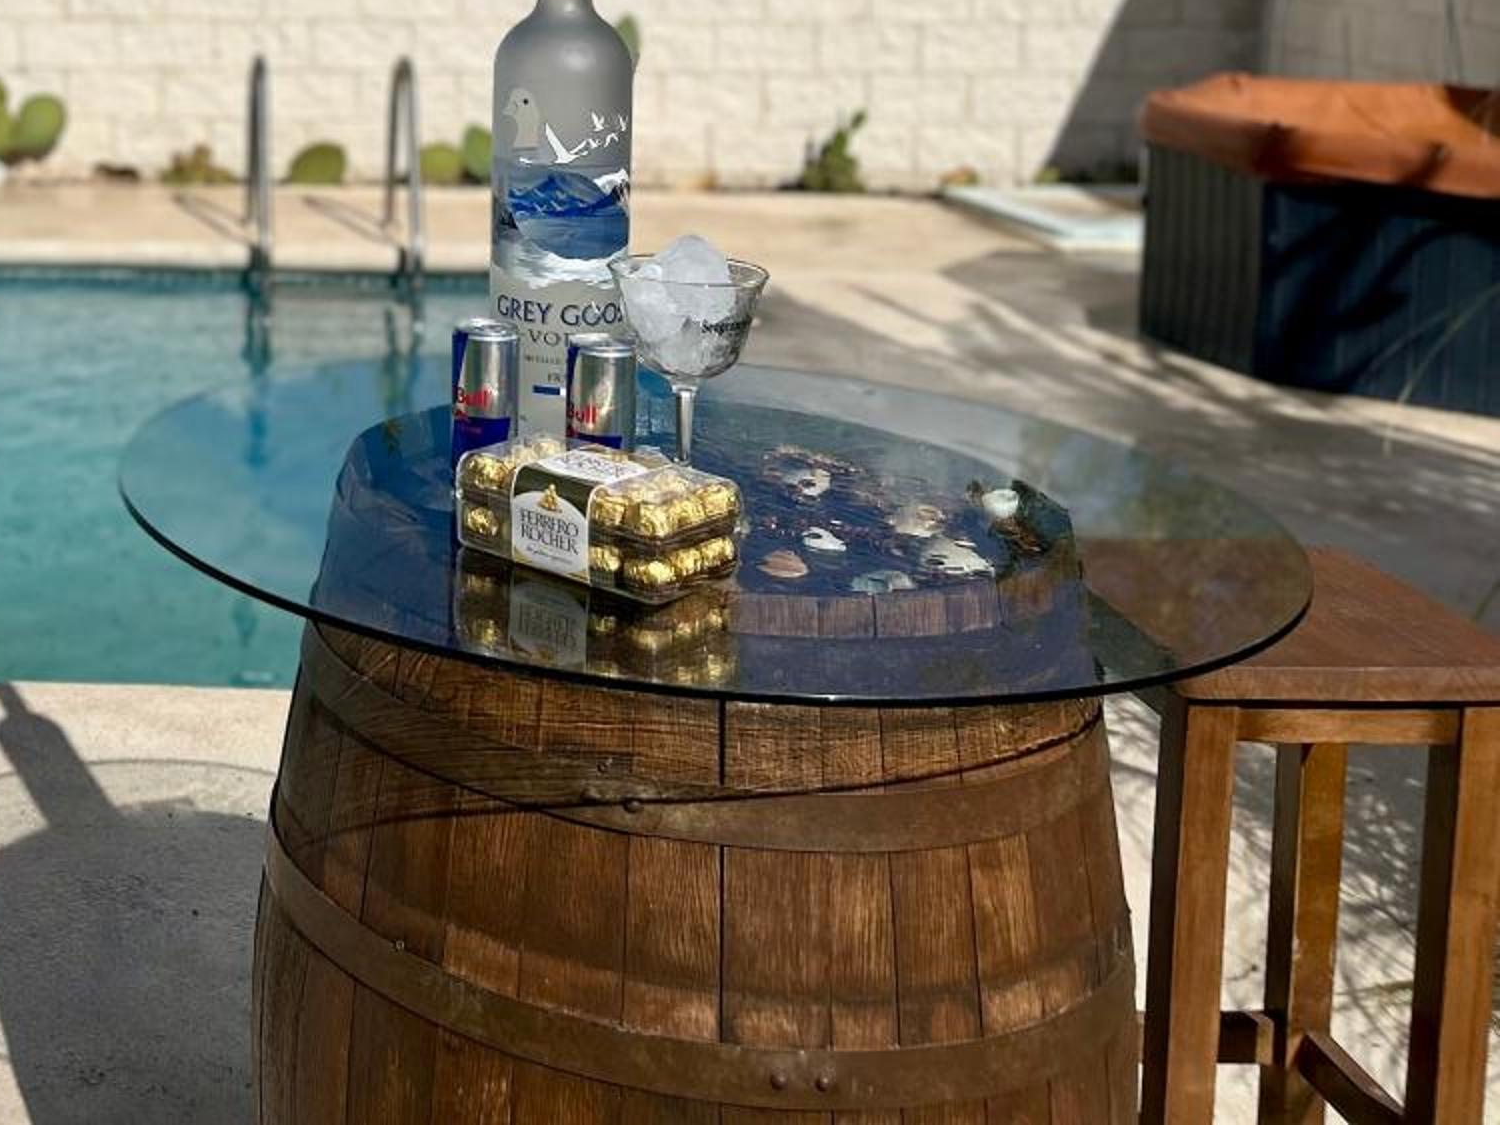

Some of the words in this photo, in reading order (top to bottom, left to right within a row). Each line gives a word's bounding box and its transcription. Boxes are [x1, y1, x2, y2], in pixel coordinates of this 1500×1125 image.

[497, 294, 551, 324] GREY
[520, 508, 579, 537] FERRERO
[520, 523, 579, 555] ROCHER
